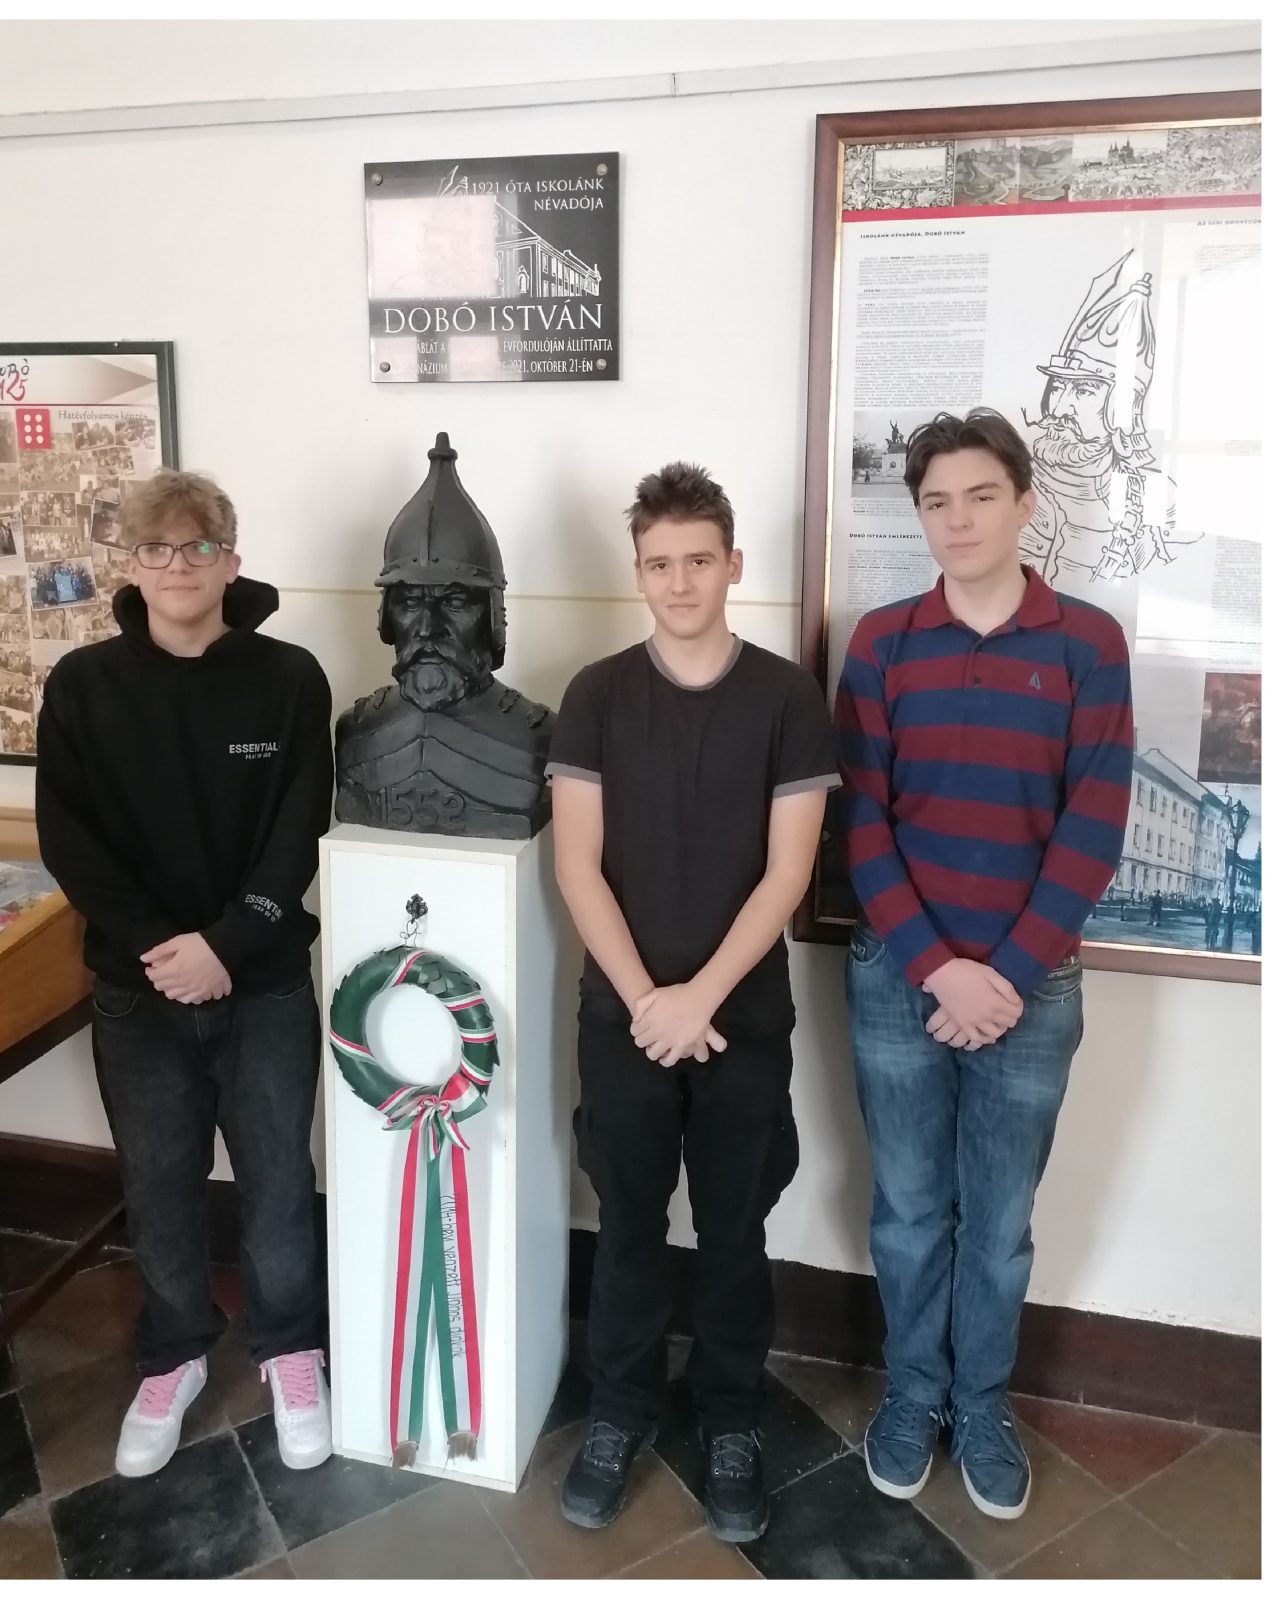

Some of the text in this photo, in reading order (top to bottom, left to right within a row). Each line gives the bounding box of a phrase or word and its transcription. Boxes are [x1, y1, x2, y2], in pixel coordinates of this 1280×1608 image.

[472, 176, 604, 194] 1921 ÓTA ISKOLÁNK
[534, 195, 604, 211] NÉVADÓJA
[383, 299, 603, 333] DOBÓ ISTVÁN
[503, 337, 565, 353] ÉVFORDULÓJÁN
[567, 336, 613, 352] ÁLLÍTTATTA
[530, 358, 568, 373] OKTÓBER
[569, 358, 593, 373] 21-ÉN
[0, 370, 29, 401] 125
[380, 785, 467, 831] 1552
